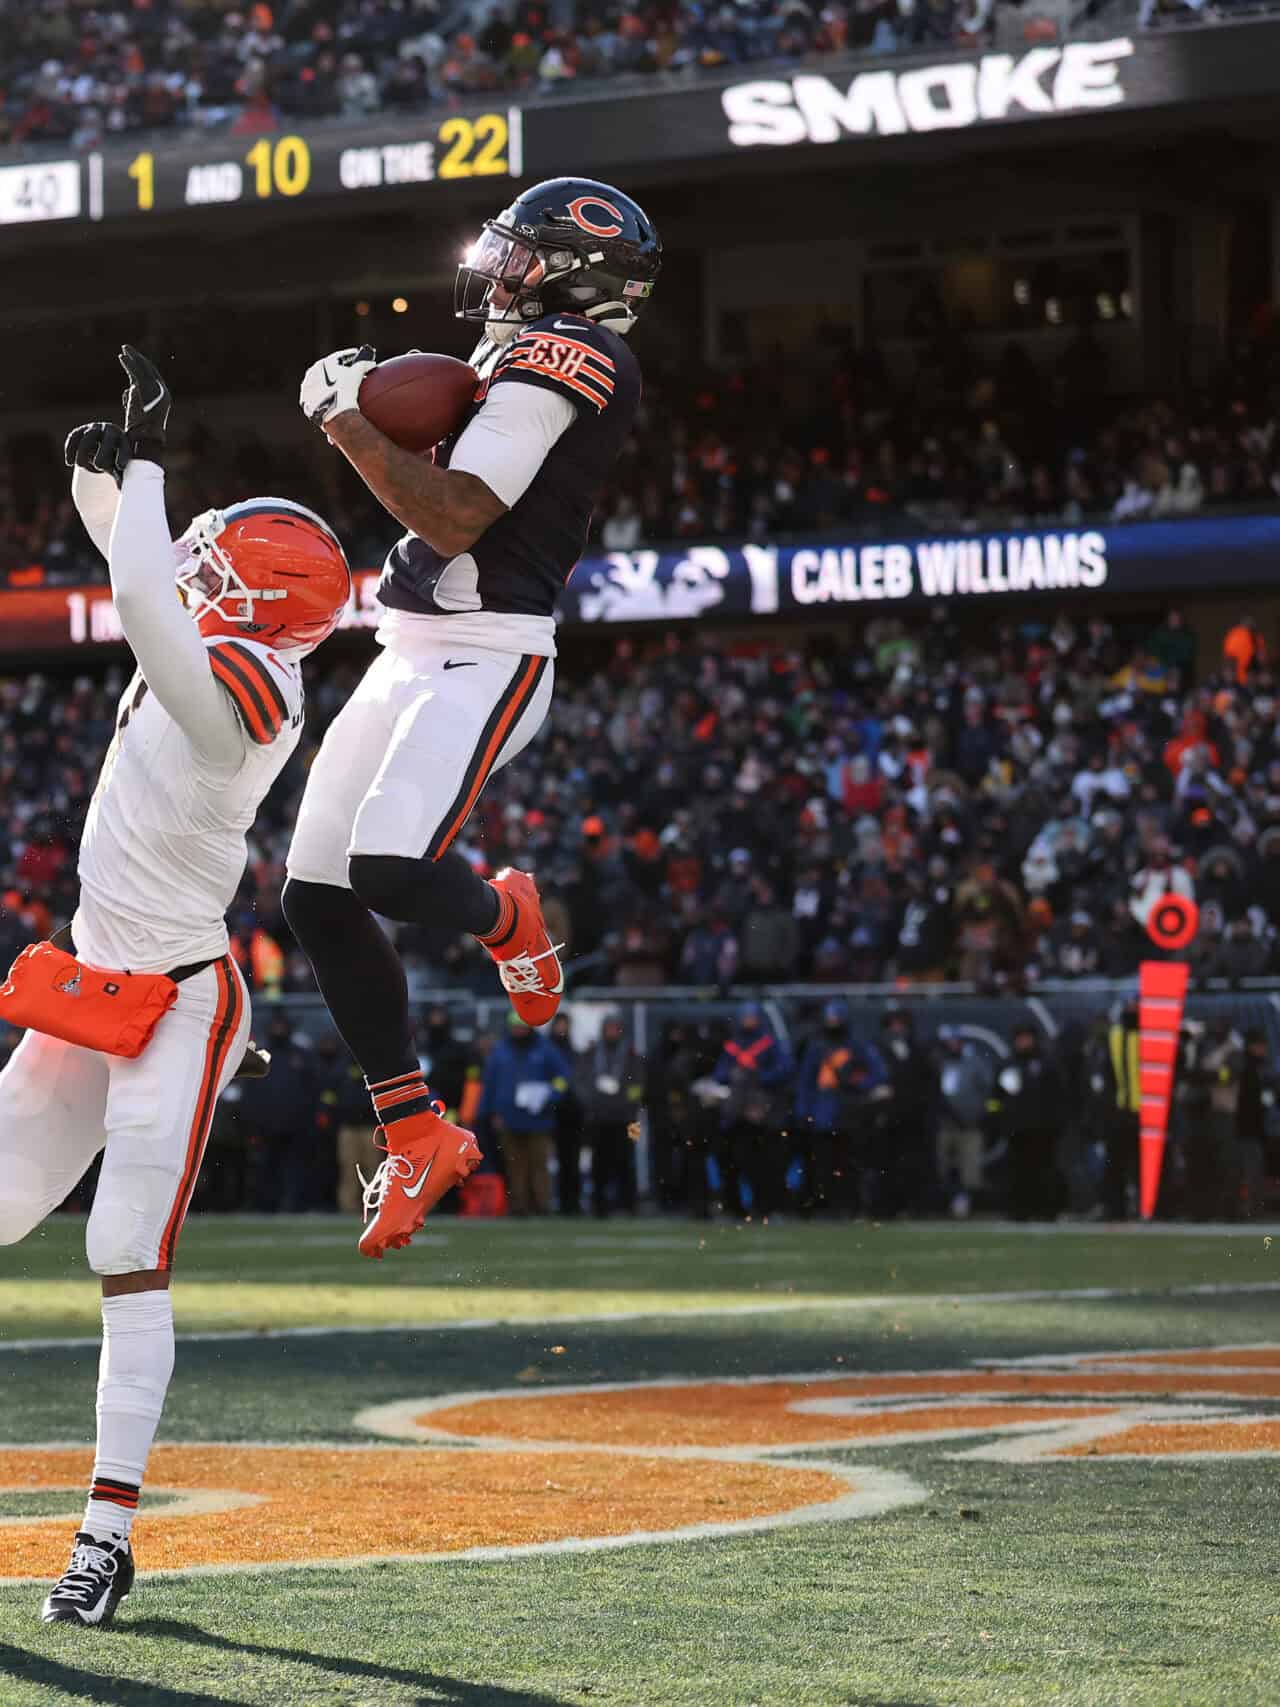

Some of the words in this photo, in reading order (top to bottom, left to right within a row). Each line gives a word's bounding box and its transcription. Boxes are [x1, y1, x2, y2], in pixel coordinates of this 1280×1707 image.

[721, 37, 1135, 147] SMOKE
[128, 152, 155, 210] 1
[246, 135, 311, 197] 10
[438, 113, 510, 180] 22
[527, 339, 588, 378] GSH
[791, 545, 914, 606] CALEB
[917, 532, 1108, 597] WILLIAMS
